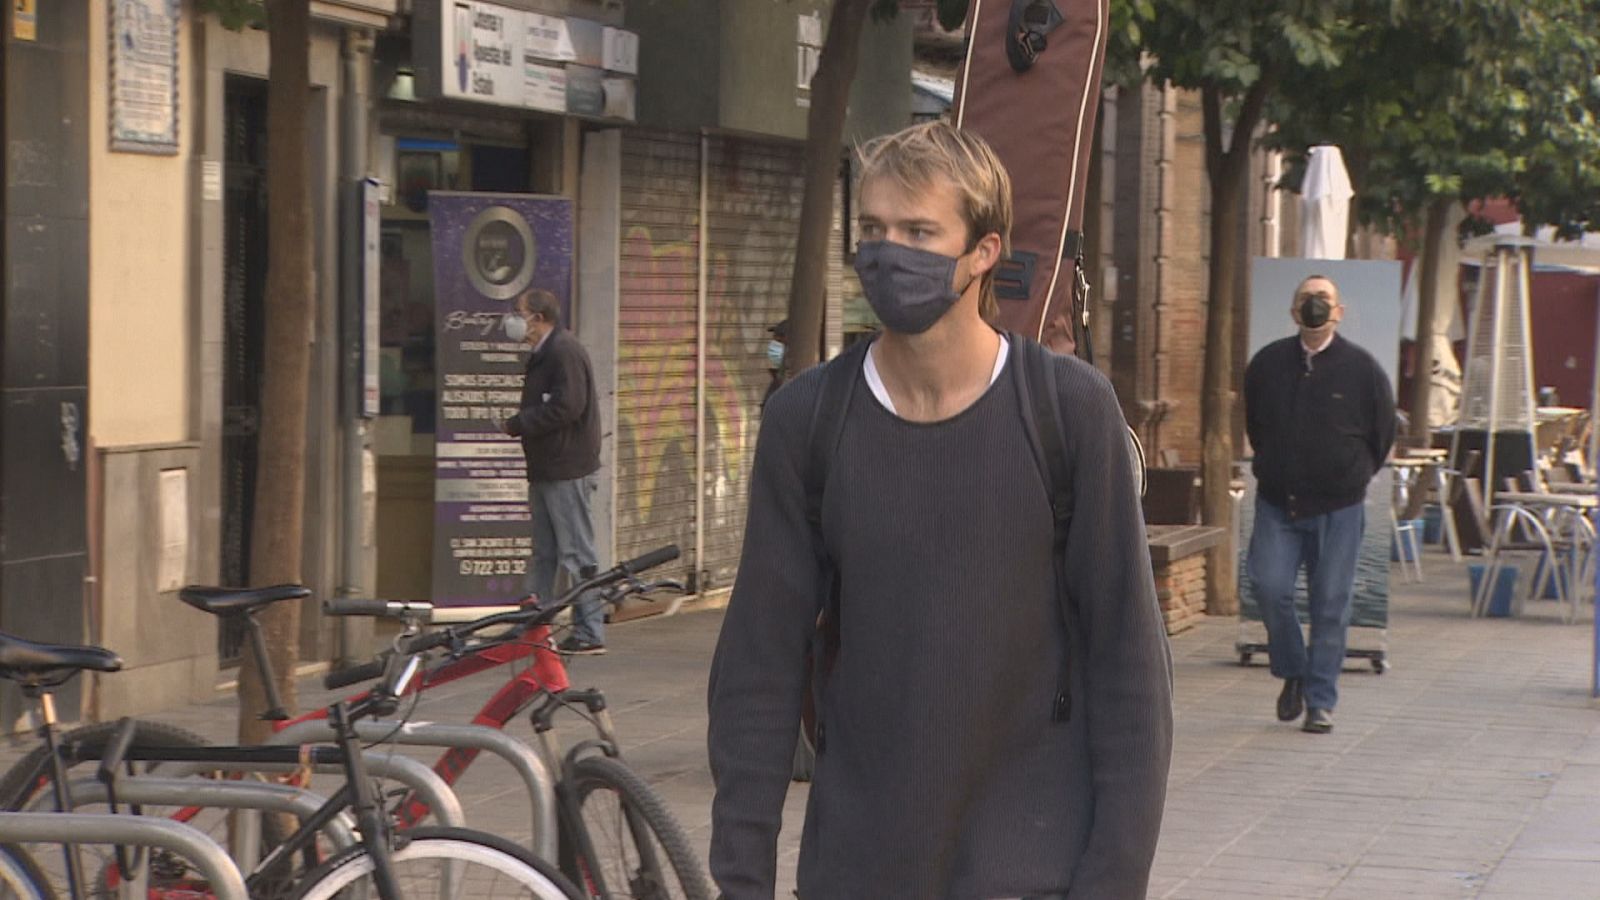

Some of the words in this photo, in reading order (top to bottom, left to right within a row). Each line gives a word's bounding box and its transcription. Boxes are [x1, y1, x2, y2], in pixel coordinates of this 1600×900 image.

[445, 374, 477, 387] SOMOS
[477, 374, 526, 388] ESPECIALIS
[442, 406, 468, 419] TODO
[469, 406, 489, 419] TIPO
[473, 559, 494, 575] 722
[495, 559, 510, 575] 33
[511, 559, 527, 575] 32
